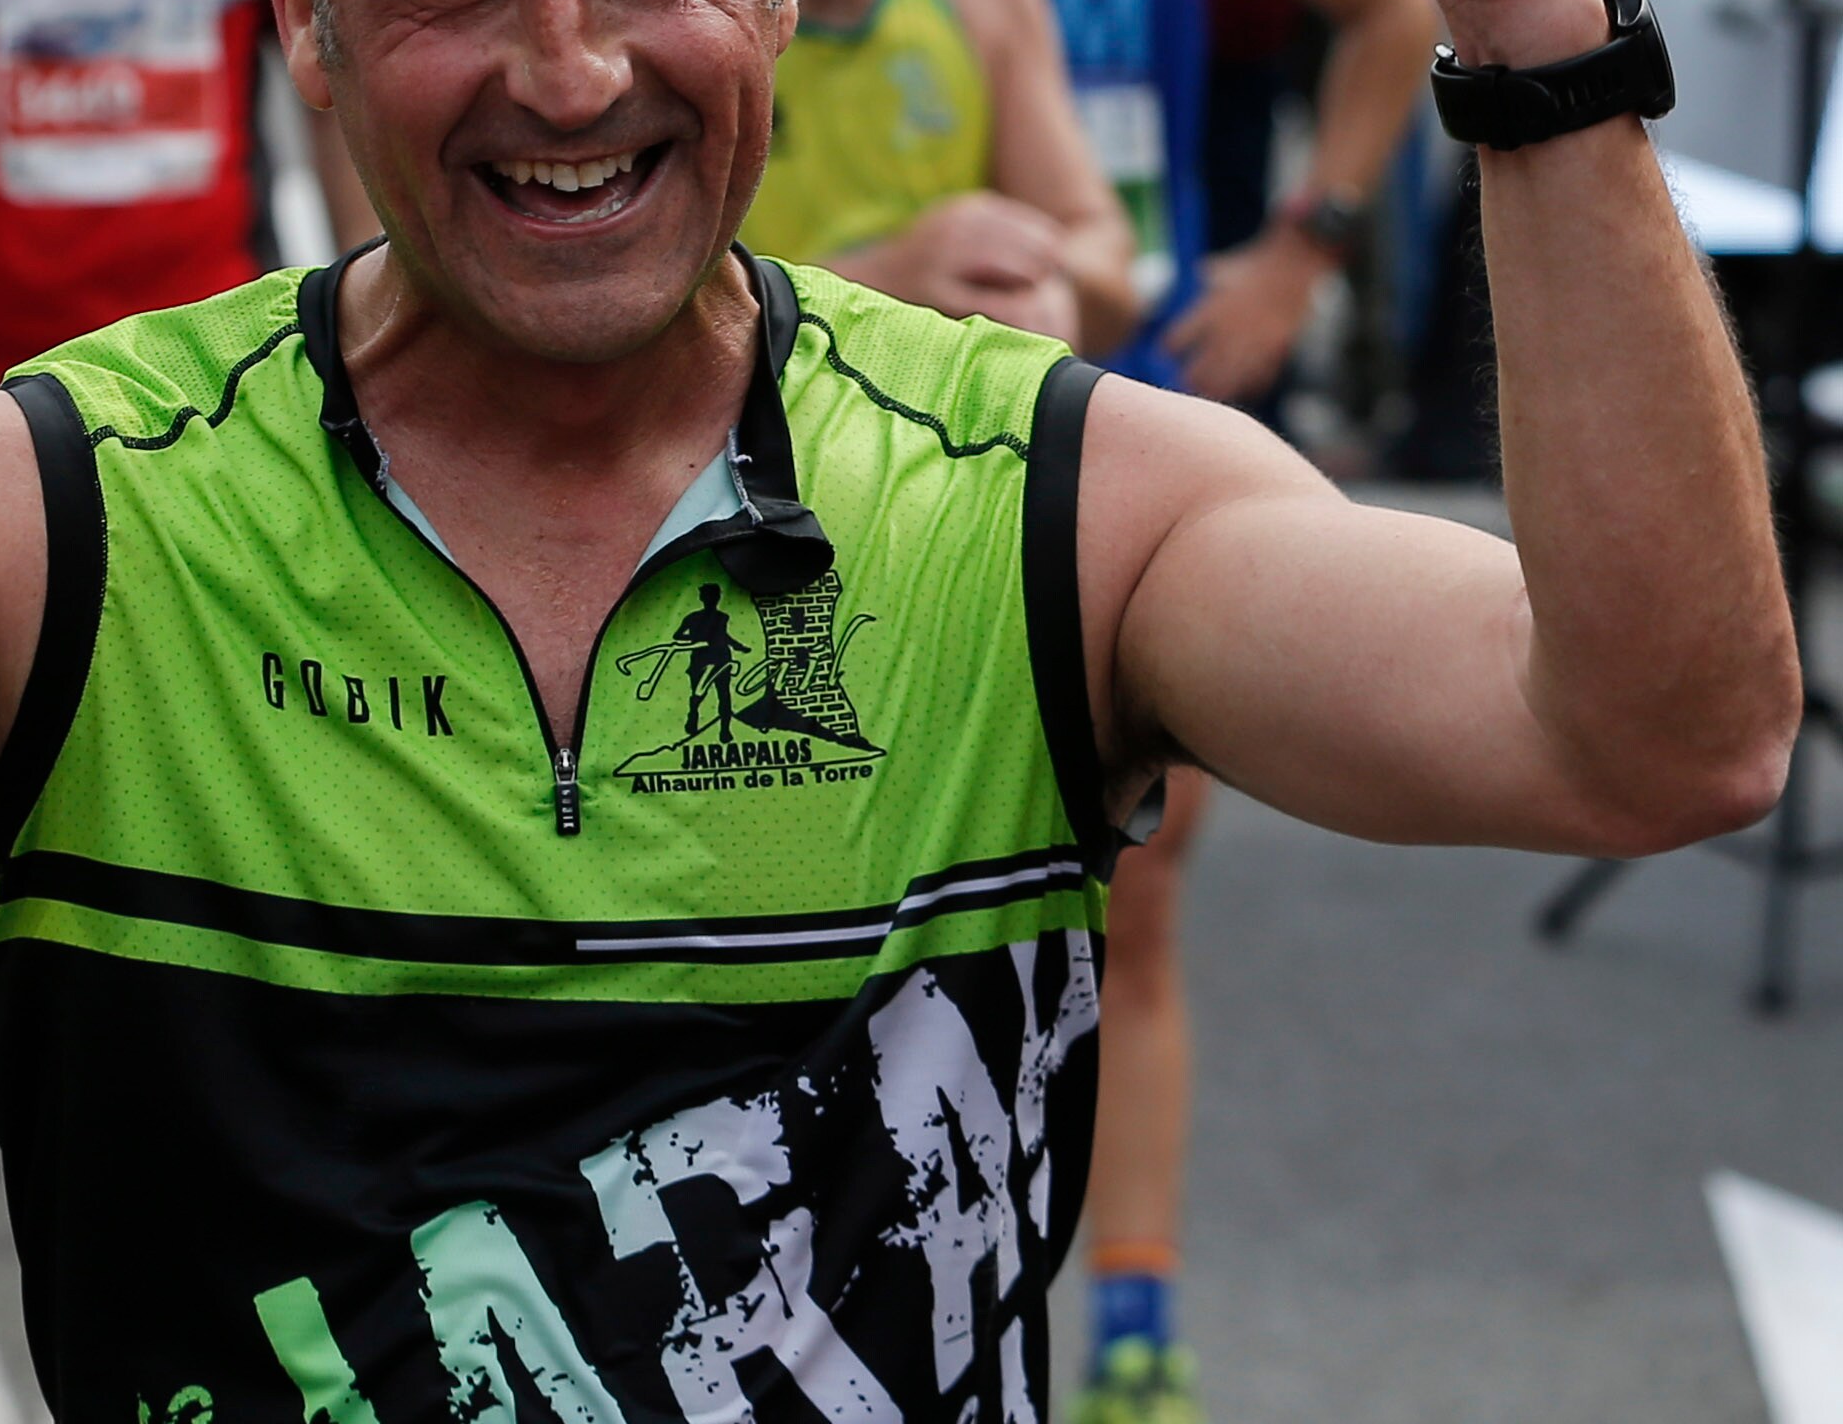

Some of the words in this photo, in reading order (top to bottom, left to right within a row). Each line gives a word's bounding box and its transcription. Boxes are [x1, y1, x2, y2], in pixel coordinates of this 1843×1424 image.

[262, 651, 454, 737] GOBIK
[681, 737, 812, 770] JARAPALOS
[631, 771, 736, 794] Alhaurín
[743, 769, 774, 789] de
[781, 767, 804, 787] la
[809, 762, 874, 784] Torre
